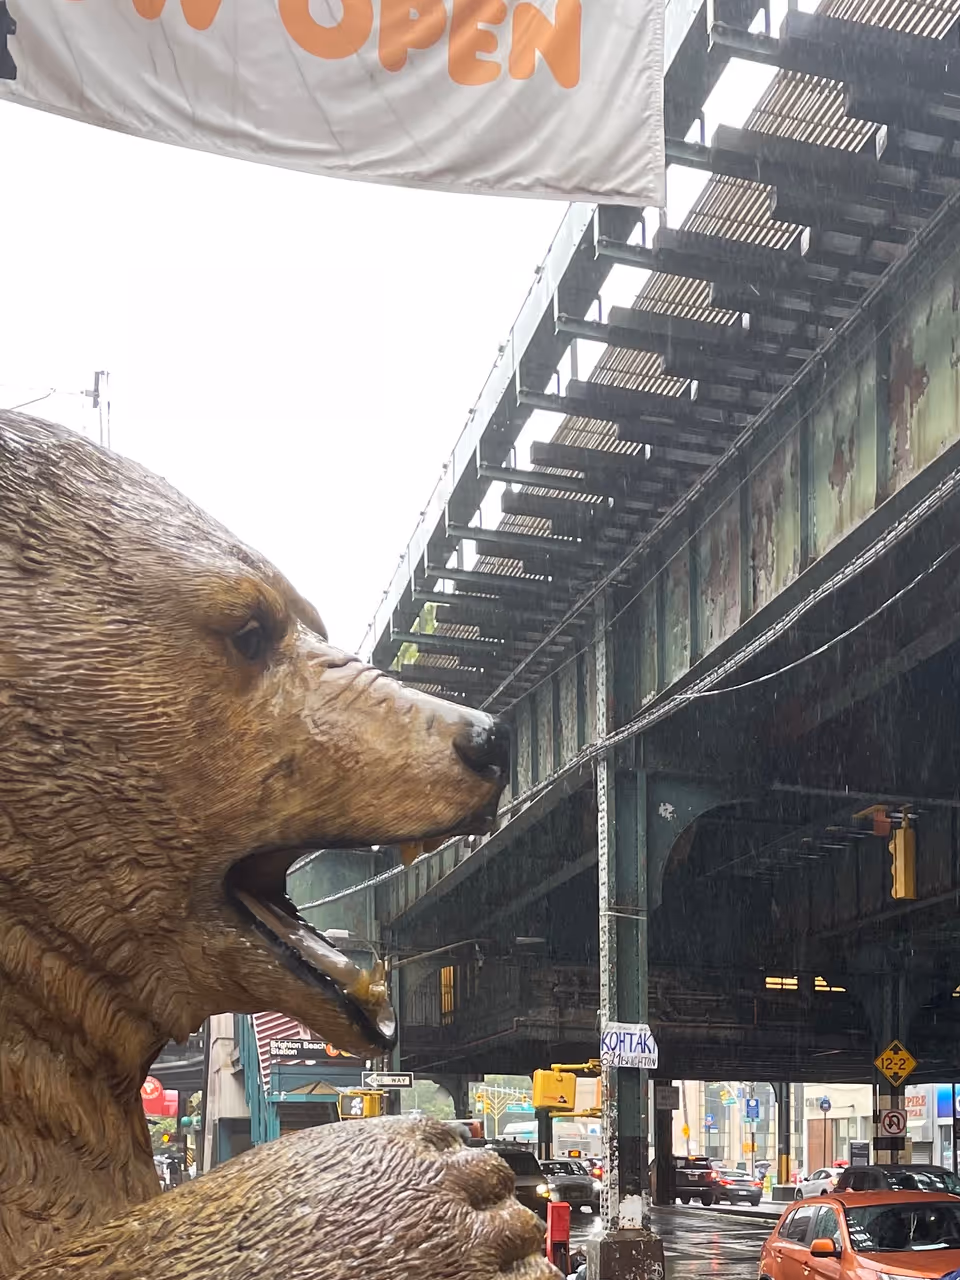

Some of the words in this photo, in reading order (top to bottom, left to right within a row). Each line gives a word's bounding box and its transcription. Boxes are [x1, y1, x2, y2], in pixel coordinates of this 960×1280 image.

[278, 0, 581, 89] OPEN
[270, 1041, 301, 1052] Brighton
[303, 1042, 327, 1050] Beach
[270, 1047, 298, 1056] Station
[370, 1076, 385, 1084] ONE
